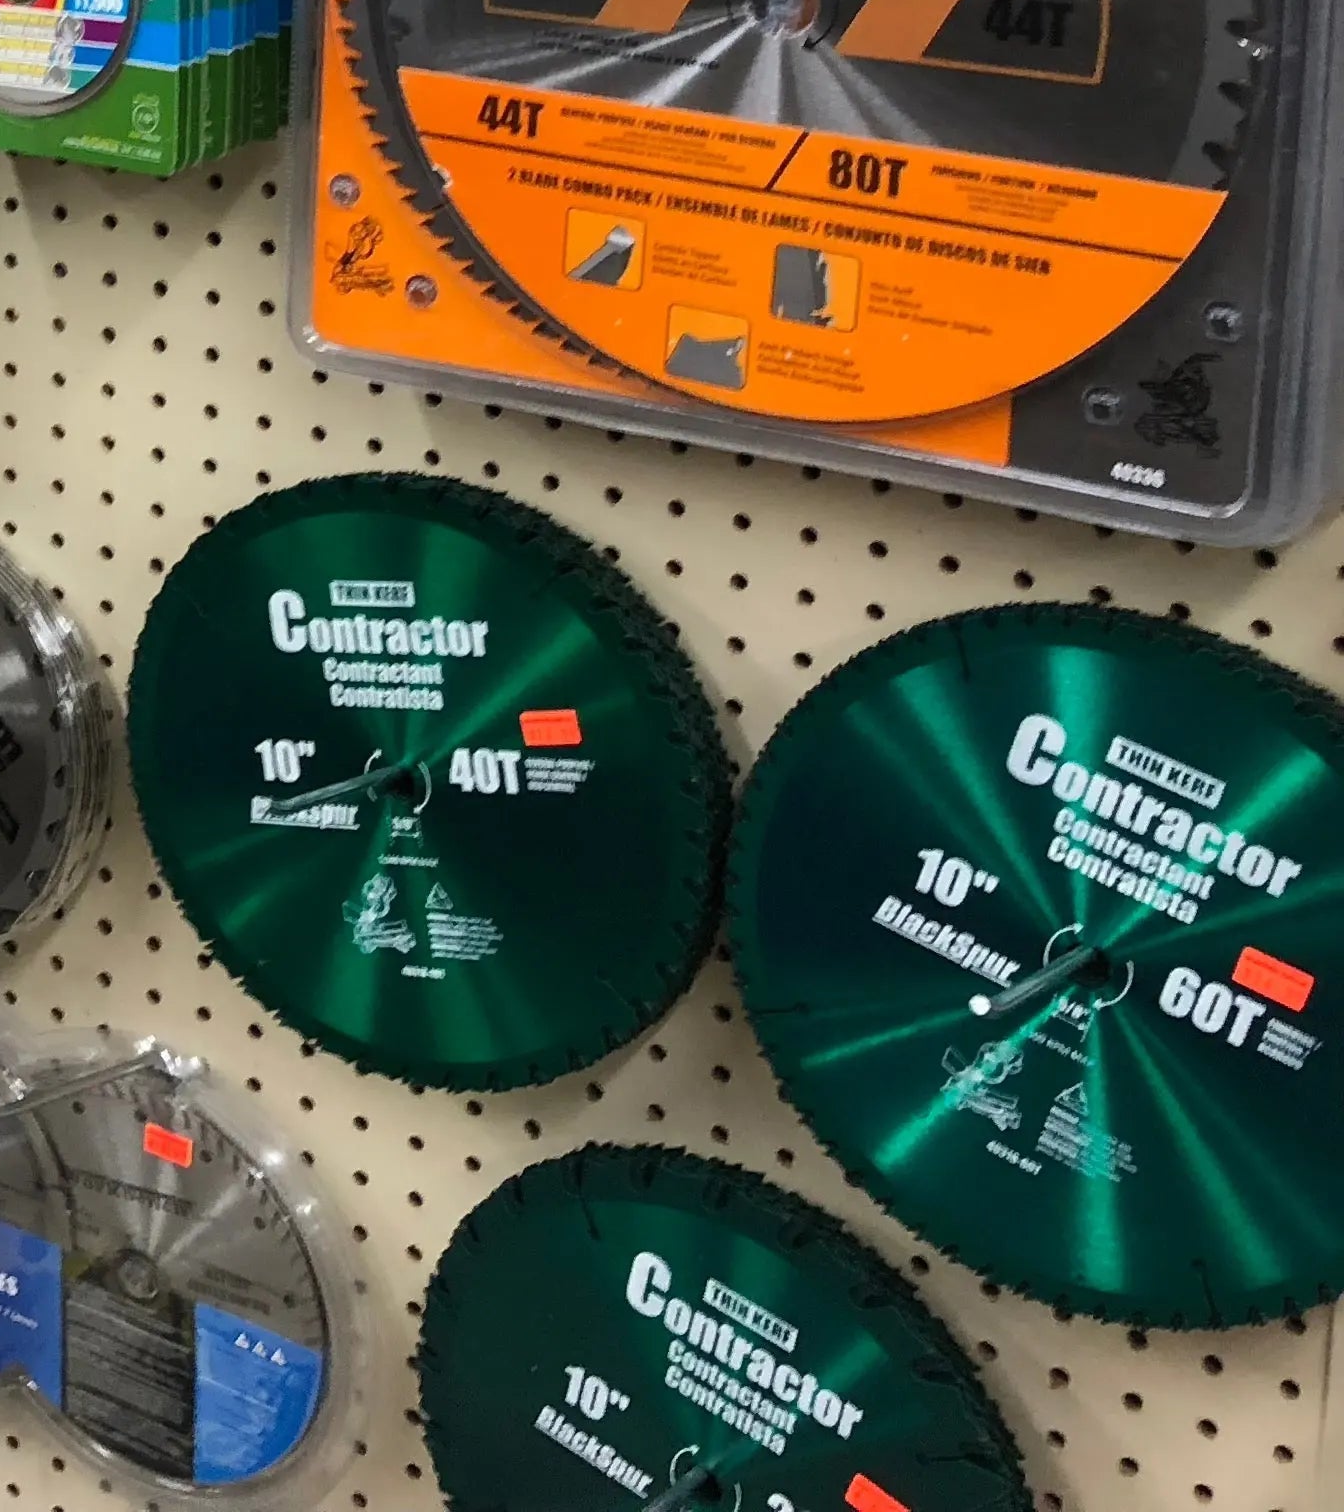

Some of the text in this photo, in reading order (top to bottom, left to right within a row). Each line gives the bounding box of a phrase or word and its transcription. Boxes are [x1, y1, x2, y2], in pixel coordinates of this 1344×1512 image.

[477, 94, 545, 137] 44T
[828, 148, 909, 199] 80T
[268, 588, 490, 658] Contractor
[322, 657, 445, 685] Contractant
[329, 683, 445, 710] Contratista
[255, 738, 316, 783] 10"
[449, 747, 522, 795] 40T
[1117, 740, 1166, 777] THIN
[1006, 713, 1302, 899] Contractor
[914, 846, 1000, 909] 10"
[1046, 834, 1200, 925] Contratista
[1053, 805, 1215, 901] Contractant
[873, 894, 1022, 987] BlackSpur
[1158, 966, 1267, 1048] 60T
[625, 1250, 864, 1441] Contractor
[563, 1364, 631, 1422] 10"
[664, 1363, 787, 1457] Contratista
[666, 1338, 798, 1435] Contractant
[534, 1403, 655, 1492] BlackSpur
